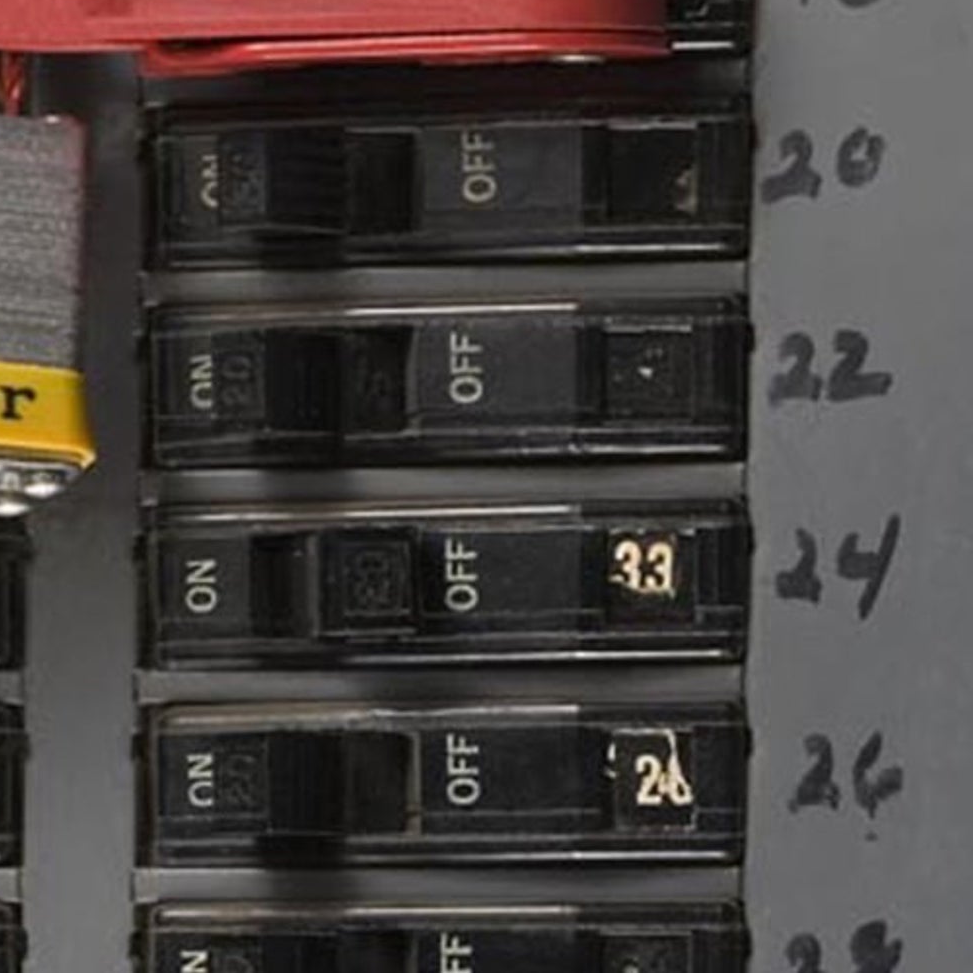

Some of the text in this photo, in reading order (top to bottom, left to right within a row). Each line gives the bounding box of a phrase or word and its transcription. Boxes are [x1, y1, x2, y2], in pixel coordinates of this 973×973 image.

[461, 133, 497, 203] OFF
[762, 127, 886, 203] 20
[450, 332, 484, 404] OFF
[770, 330, 893, 405] 22
[185, 559, 218, 613] ON
[445, 538, 479, 612] OFF
[775, 514, 901, 620] 24
[186, 753, 214, 807] ON
[446, 733, 480, 805] OFF
[440, 932, 473, 973] FF
